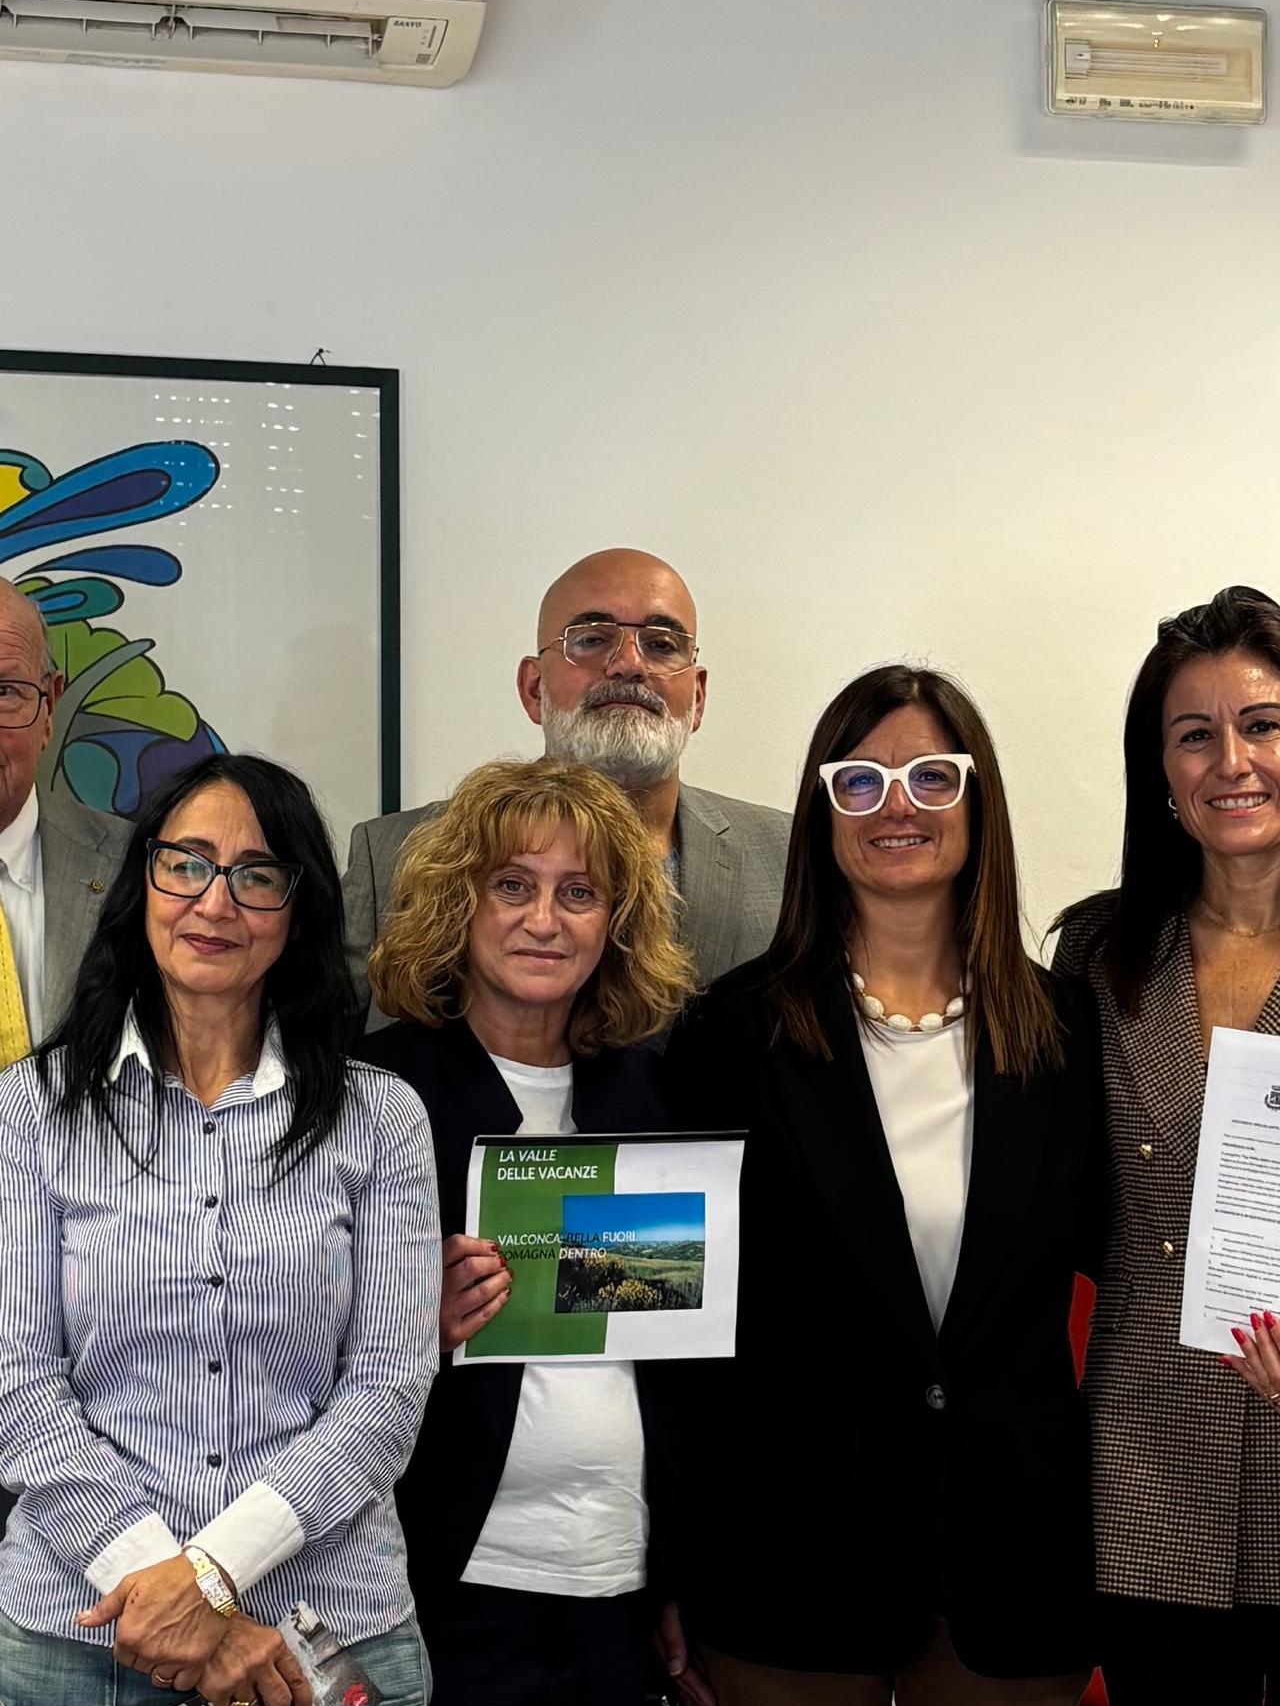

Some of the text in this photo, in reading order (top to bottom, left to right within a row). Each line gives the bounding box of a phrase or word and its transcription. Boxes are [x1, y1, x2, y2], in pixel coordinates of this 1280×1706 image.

[499, 1149, 558, 1162] LA VALLE
[497, 1166, 598, 1180] DELLE VACANZE
[567, 1232, 600, 1244] BELLA
[602, 1230, 636, 1243] FUORI
[559, 1247, 607, 1260] DENTRO
